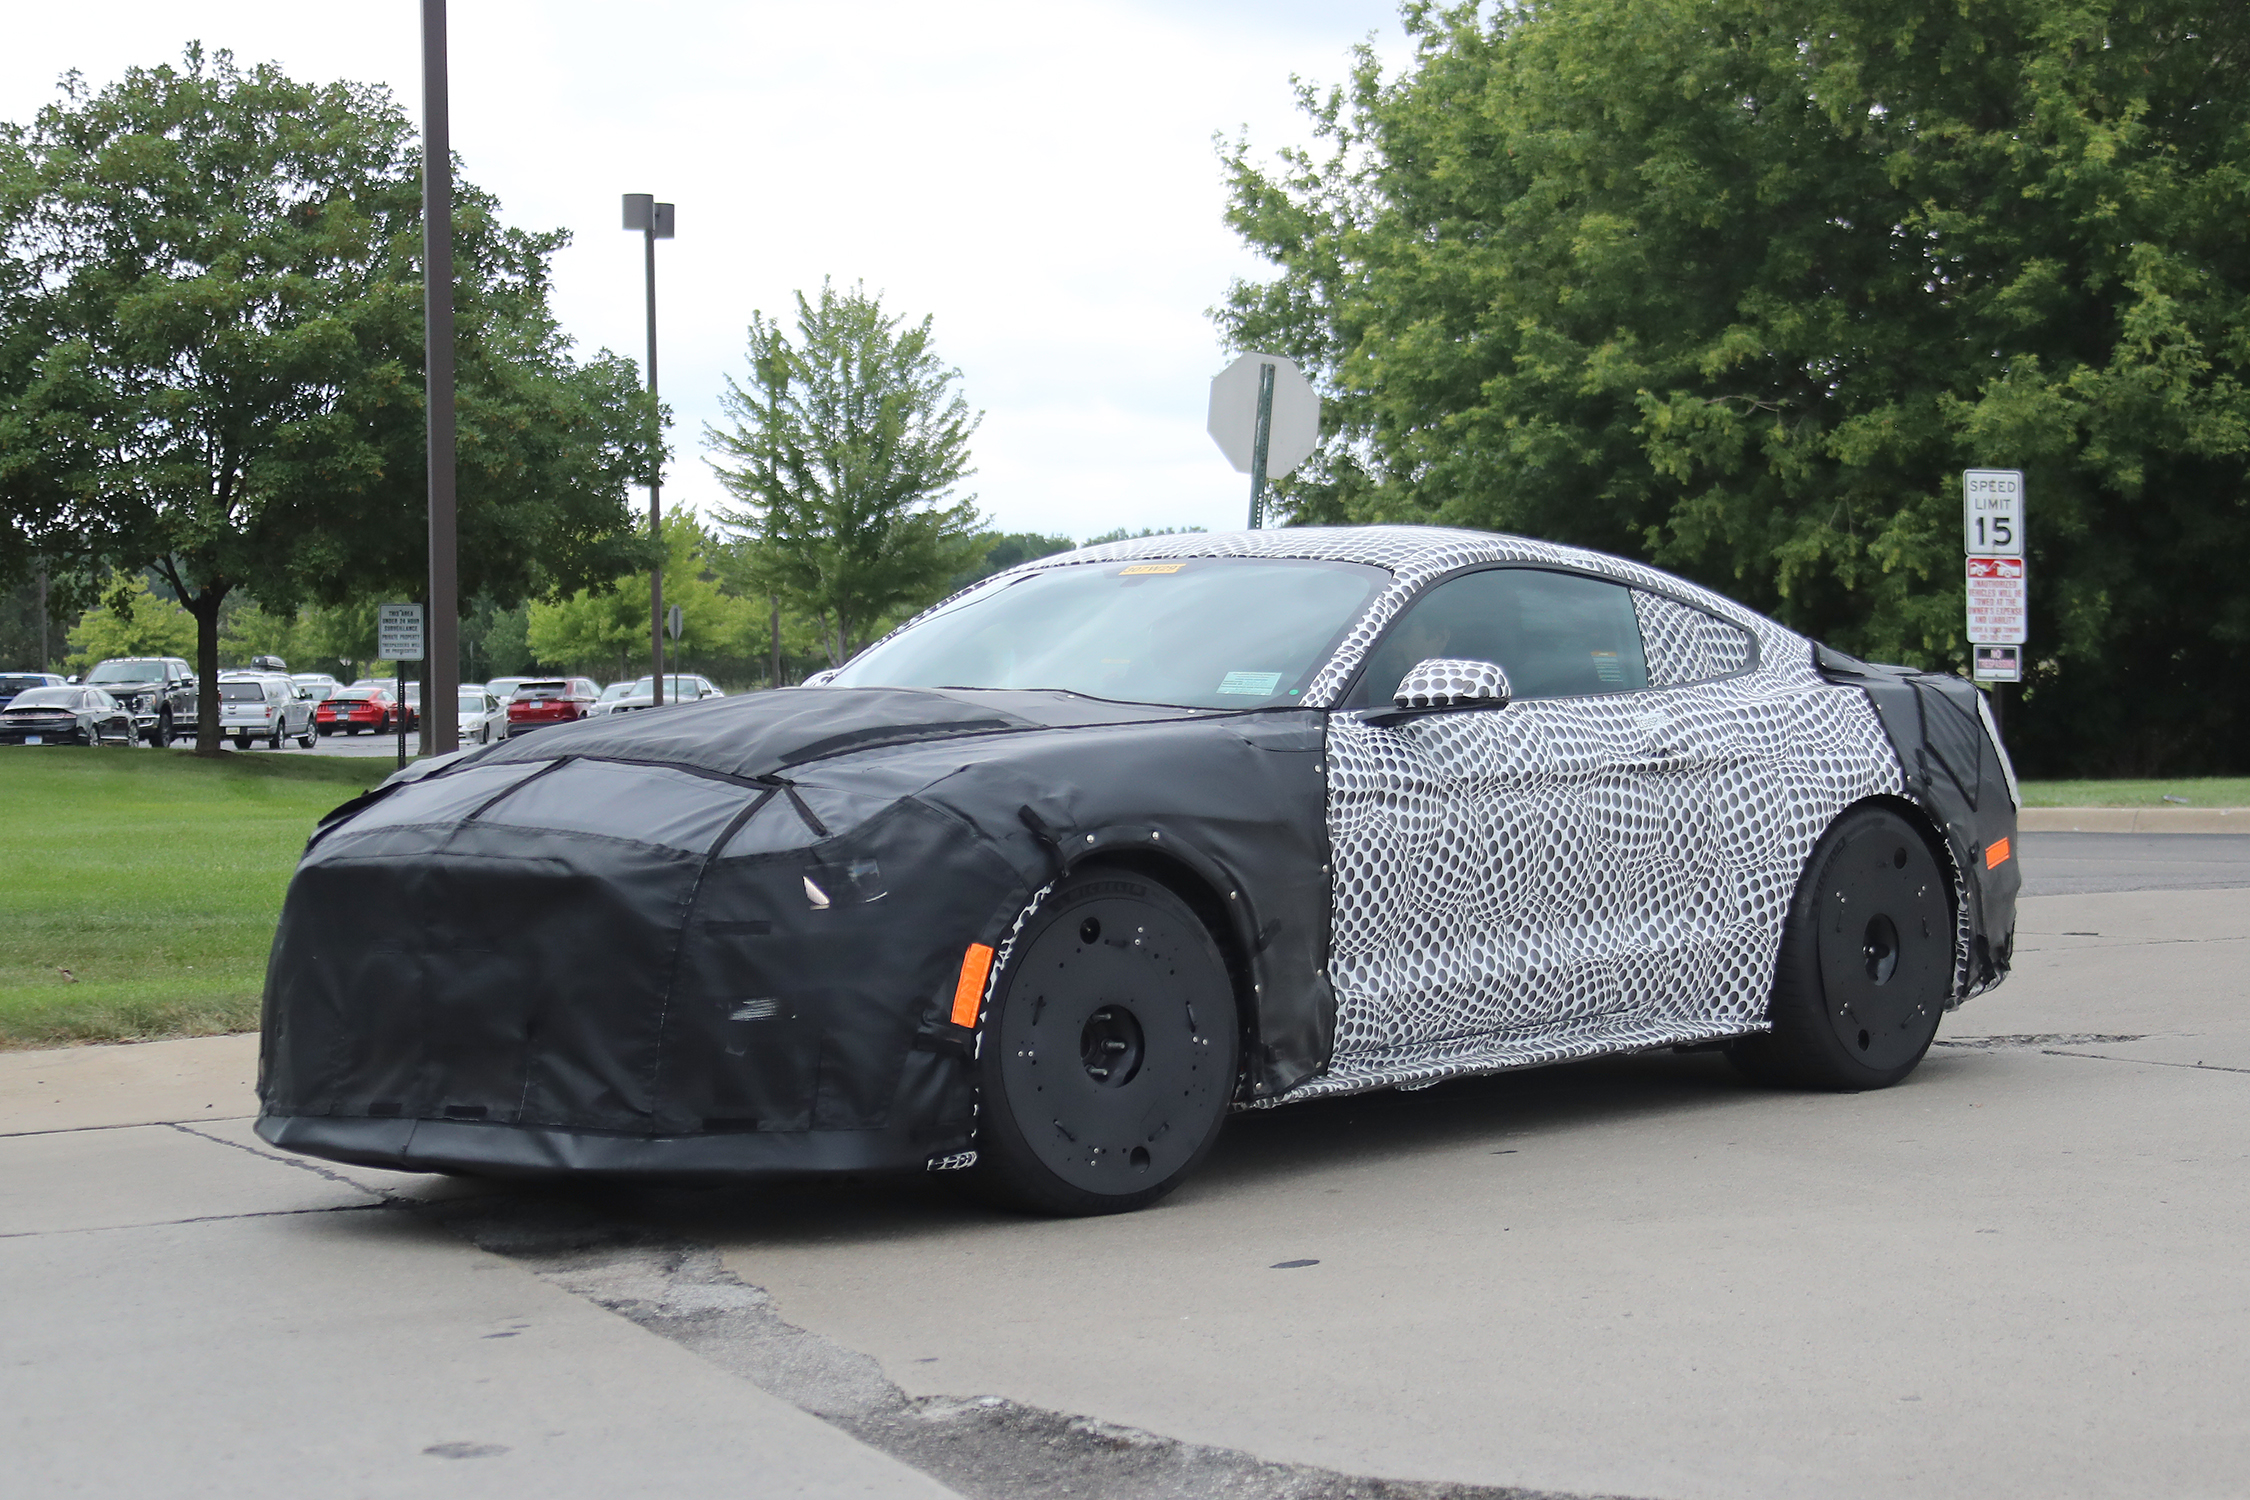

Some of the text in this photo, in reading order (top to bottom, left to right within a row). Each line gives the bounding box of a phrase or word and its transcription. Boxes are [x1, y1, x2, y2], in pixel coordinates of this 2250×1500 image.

[1970, 480, 2016, 493] SPEED
[1975, 499, 2010, 510] LIMIT
[1976, 516, 2012, 546] 15
[1973, 580, 2017, 588] UNAUTHORIZED
[1968, 589, 1996, 597] VEHICLES
[1999, 589, 2012, 597] WILL
[1974, 598, 1994, 606] TOWED
[1996, 598, 2003, 606] AT
[1968, 607, 2022, 615] OWNER'S EXPENSE
[1989, 616, 2016, 624] LIABILITY
[1991, 649, 2003, 659] NO
[1978, 659, 2016, 669] TRESPASSING
